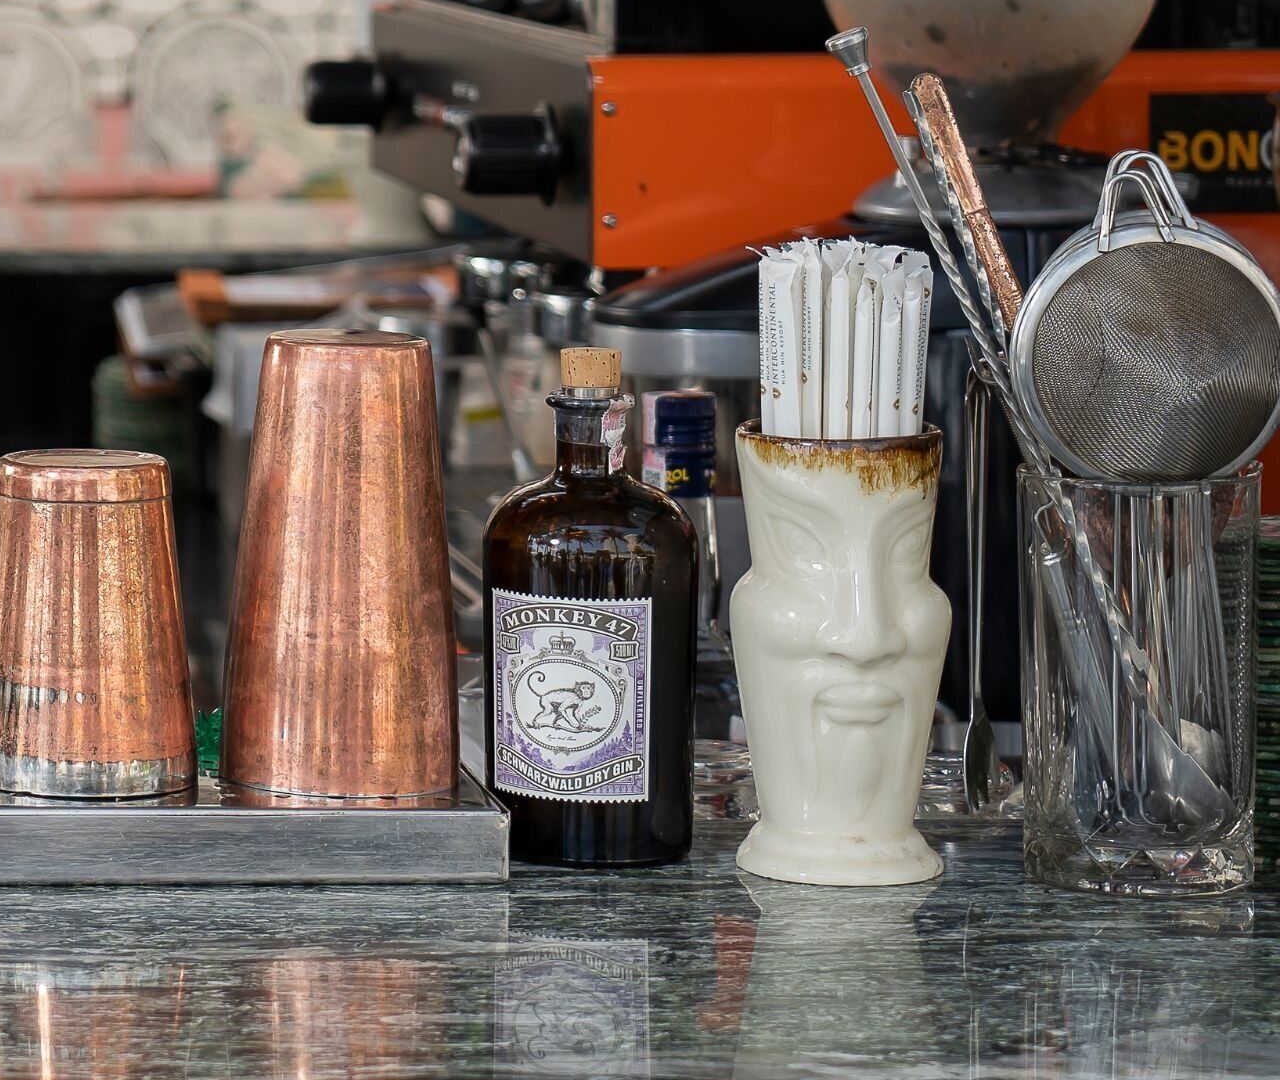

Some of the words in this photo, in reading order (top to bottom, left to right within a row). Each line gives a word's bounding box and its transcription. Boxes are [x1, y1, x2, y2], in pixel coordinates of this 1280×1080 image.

[769, 283, 779, 385] INTERCONTINENTAL
[504, 607, 604, 629] MONKEY
[605, 617, 632, 636] 47
[502, 750, 582, 791] SCHWARZWALD
[585, 768, 611, 786] DRY
[612, 758, 634, 776] GIN
